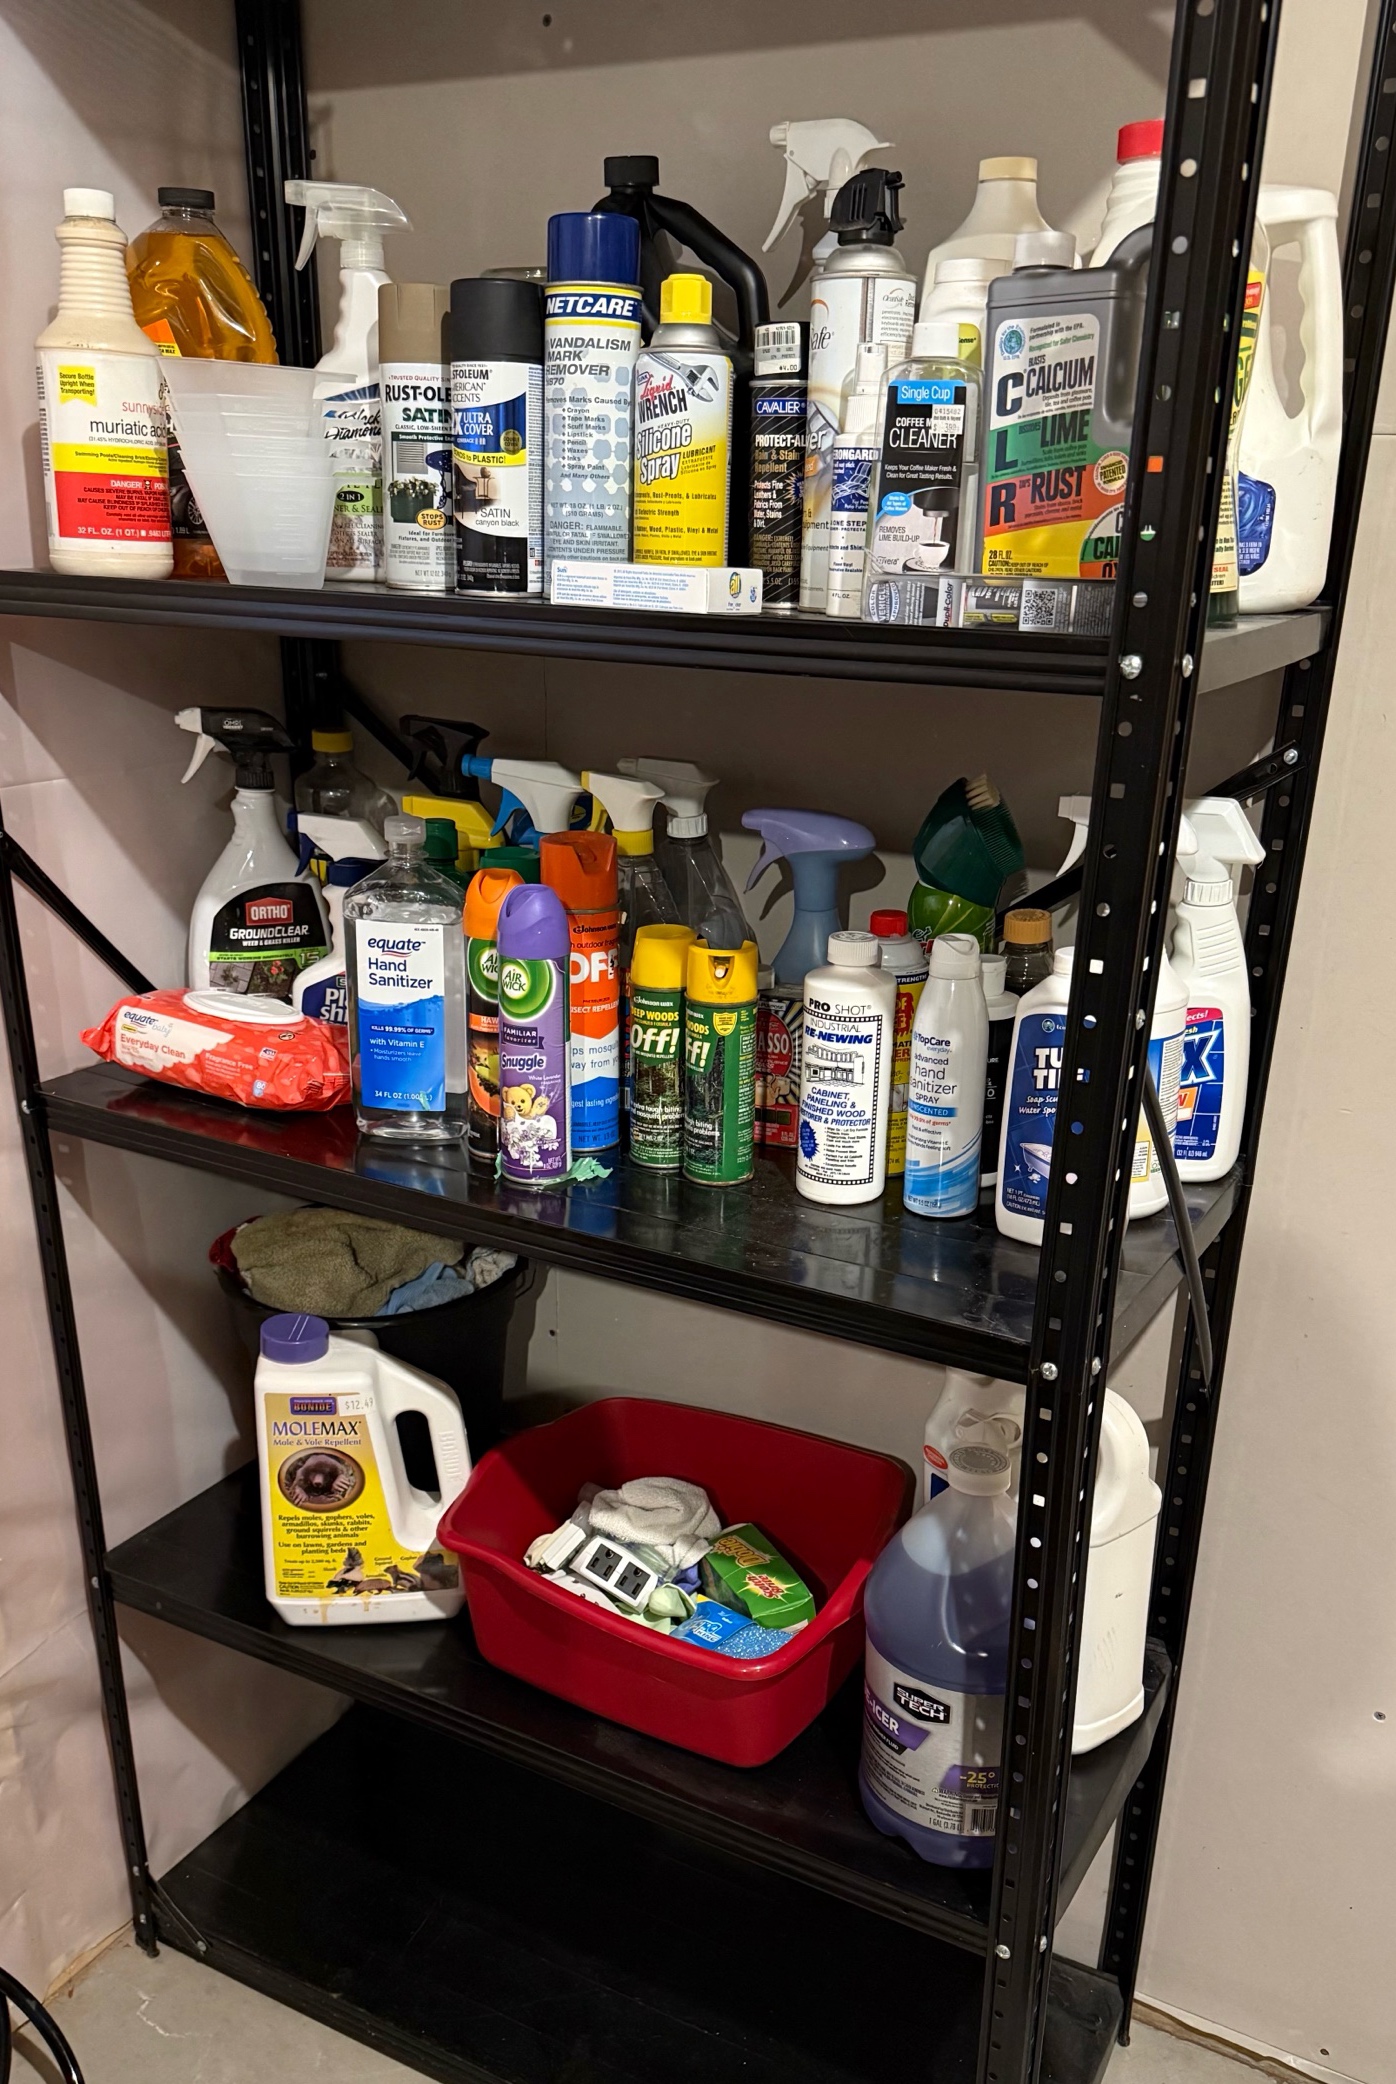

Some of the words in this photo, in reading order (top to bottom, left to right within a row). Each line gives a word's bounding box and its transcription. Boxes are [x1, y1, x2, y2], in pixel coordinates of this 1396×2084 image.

[546, 296, 634, 316] NETCARE
[550, 337, 631, 351] VANDALISM
[548, 350, 584, 362] MARK
[1029, 354, 1046, 367] BLASTS
[546, 363, 610, 376] REMOVER
[1025, 356, 1095, 398] CALCIUM
[640, 374, 673, 401] Liquid
[901, 386, 930, 401] Single
[931, 386, 951, 402] Cup
[996, 372, 1024, 417] C
[594, 397, 622, 405] Caused
[638, 388, 688, 424] WRENCH
[756, 402, 800, 413] CAVALIER
[463, 412, 492, 423] ULTRA
[567, 407, 590, 415] Crayon
[90, 419, 148, 436] muriatic
[896, 417, 925, 427] COFFEE
[464, 424, 494, 436] COVER
[636, 423, 692, 460] Silicone
[889, 428, 957, 449] CLEANER
[995, 430, 1019, 473] L
[1040, 409, 1091, 448] LIME
[682, 445, 716, 459] LUBRICANT
[473, 455, 506, 464] PLASTIC!
[640, 451, 681, 486] Spray
[1100, 465, 1126, 480] PATENTED
[110, 480, 142, 488] DANGER!
[772, 480, 783, 489] Fine
[990, 482, 1017, 527] R
[1031, 464, 1086, 504] RUST
[480, 508, 511, 518] SATIN
[475, 519, 499, 527] canyon
[501, 519, 519, 527] black
[989, 550, 997, 559] 28
[251, 905, 288, 920] ORTHO
[230, 925, 308, 939] GROUNDCLEAR
[367, 938, 422, 953] equate
[300, 952, 320, 964] 15
[368, 957, 407, 973] Hand
[368, 973, 433, 989] Sanitizer
[503, 981, 526, 991] WICK
[809, 997, 831, 1012] PRO
[835, 1004, 866, 1016] SHOT
[124, 1011, 155, 1025] equate
[646, 1011, 679, 1021] WOODS
[504, 1027, 537, 1036] FAMILIAR
[811, 1017, 861, 1032] INDUSTRIAL
[504, 1035, 536, 1043] favorites
[631, 1024, 680, 1054] Off!
[805, 1025, 873, 1044] RE-NEWING
[917, 1034, 951, 1047] TopCare
[121, 1034, 159, 1053] Everyday
[162, 1045, 186, 1059] Clean
[388, 1039, 418, 1047] Vitamin
[927, 1046, 950, 1054] everyday
[205, 1052, 236, 1067] Fragrance
[238, 1061, 253, 1070] Free
[502, 1054, 544, 1071] Snuggle
[590, 1059, 610, 1068] from
[914, 1053, 948, 1065] advanced
[915, 1062, 945, 1080] hand
[910, 1077, 957, 1095] sanitizer
[811, 1086, 850, 1101] CABINET,
[916, 1093, 940, 1104] SPRAY
[801, 1100, 833, 1116] FINISHED
[807, 1094, 847, 1109] PANELING
[830, 1118, 871, 1126] PROTECTOR
[922, 1127, 942, 1135] effective
[294, 1402, 333, 1412] BONIDE
[345, 1397, 374, 1410] $12.49
[273, 1421, 358, 1436] MOLEMAX
[324, 1439, 362, 1447] Repellent
[896, 1687, 945, 1711] SUPER
[897, 1695, 945, 1721] TECH
